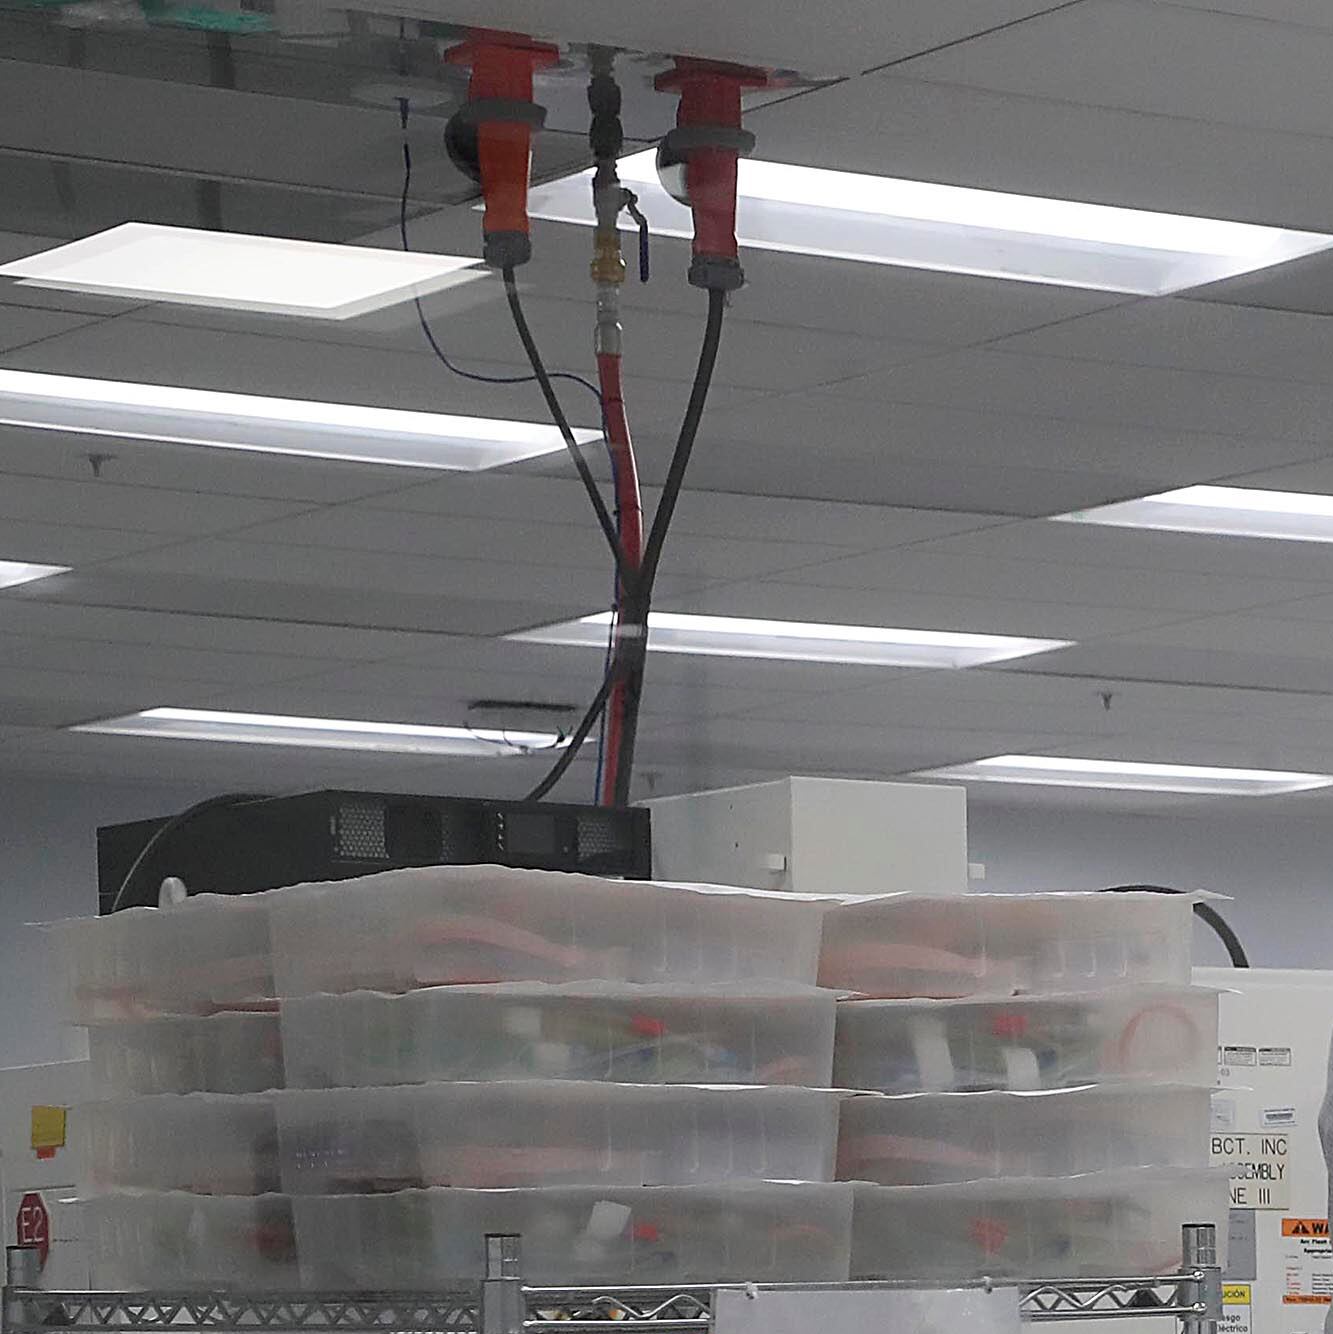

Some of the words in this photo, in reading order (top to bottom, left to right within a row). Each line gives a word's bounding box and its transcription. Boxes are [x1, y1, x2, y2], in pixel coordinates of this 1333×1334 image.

[1261, 1138, 1288, 1156] INC
[1258, 1188, 1271, 1205] III
[20, 1206, 45, 1243] E2
